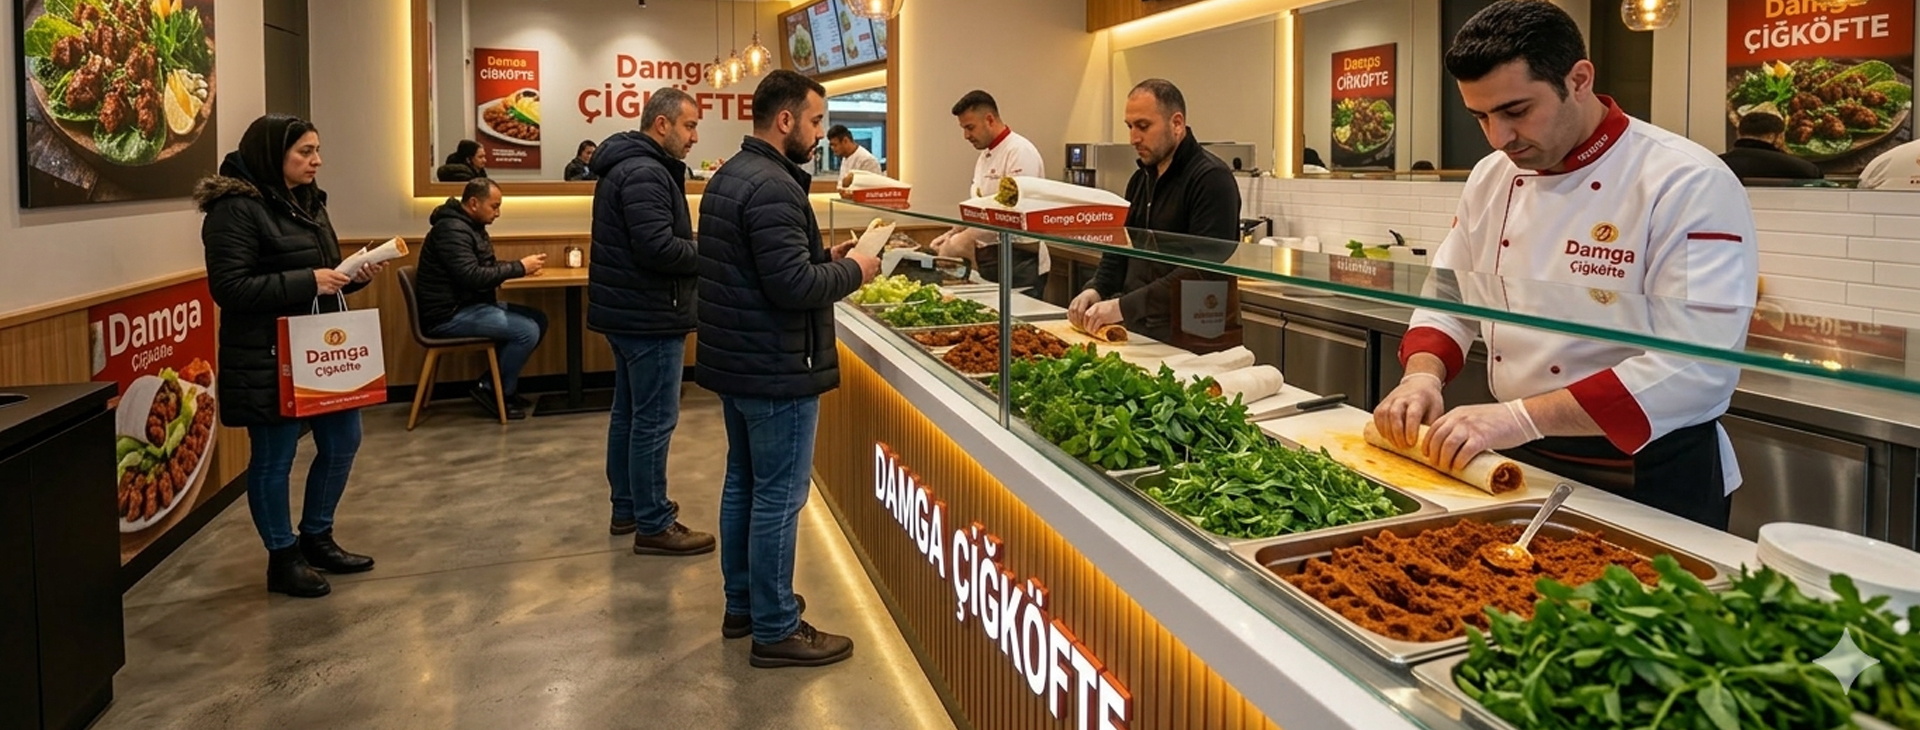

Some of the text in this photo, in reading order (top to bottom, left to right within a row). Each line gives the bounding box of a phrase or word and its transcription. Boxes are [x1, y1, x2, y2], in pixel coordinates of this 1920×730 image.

[1744, 14, 1889, 54] ÇİĞKÖFTE
[578, 83, 754, 124] ÇİĞFTE
[1565, 240, 1635, 265] Damga
[108, 299, 202, 357] Damga
[306, 346, 369, 364] Damga
[874, 441, 947, 579] DAMGA
